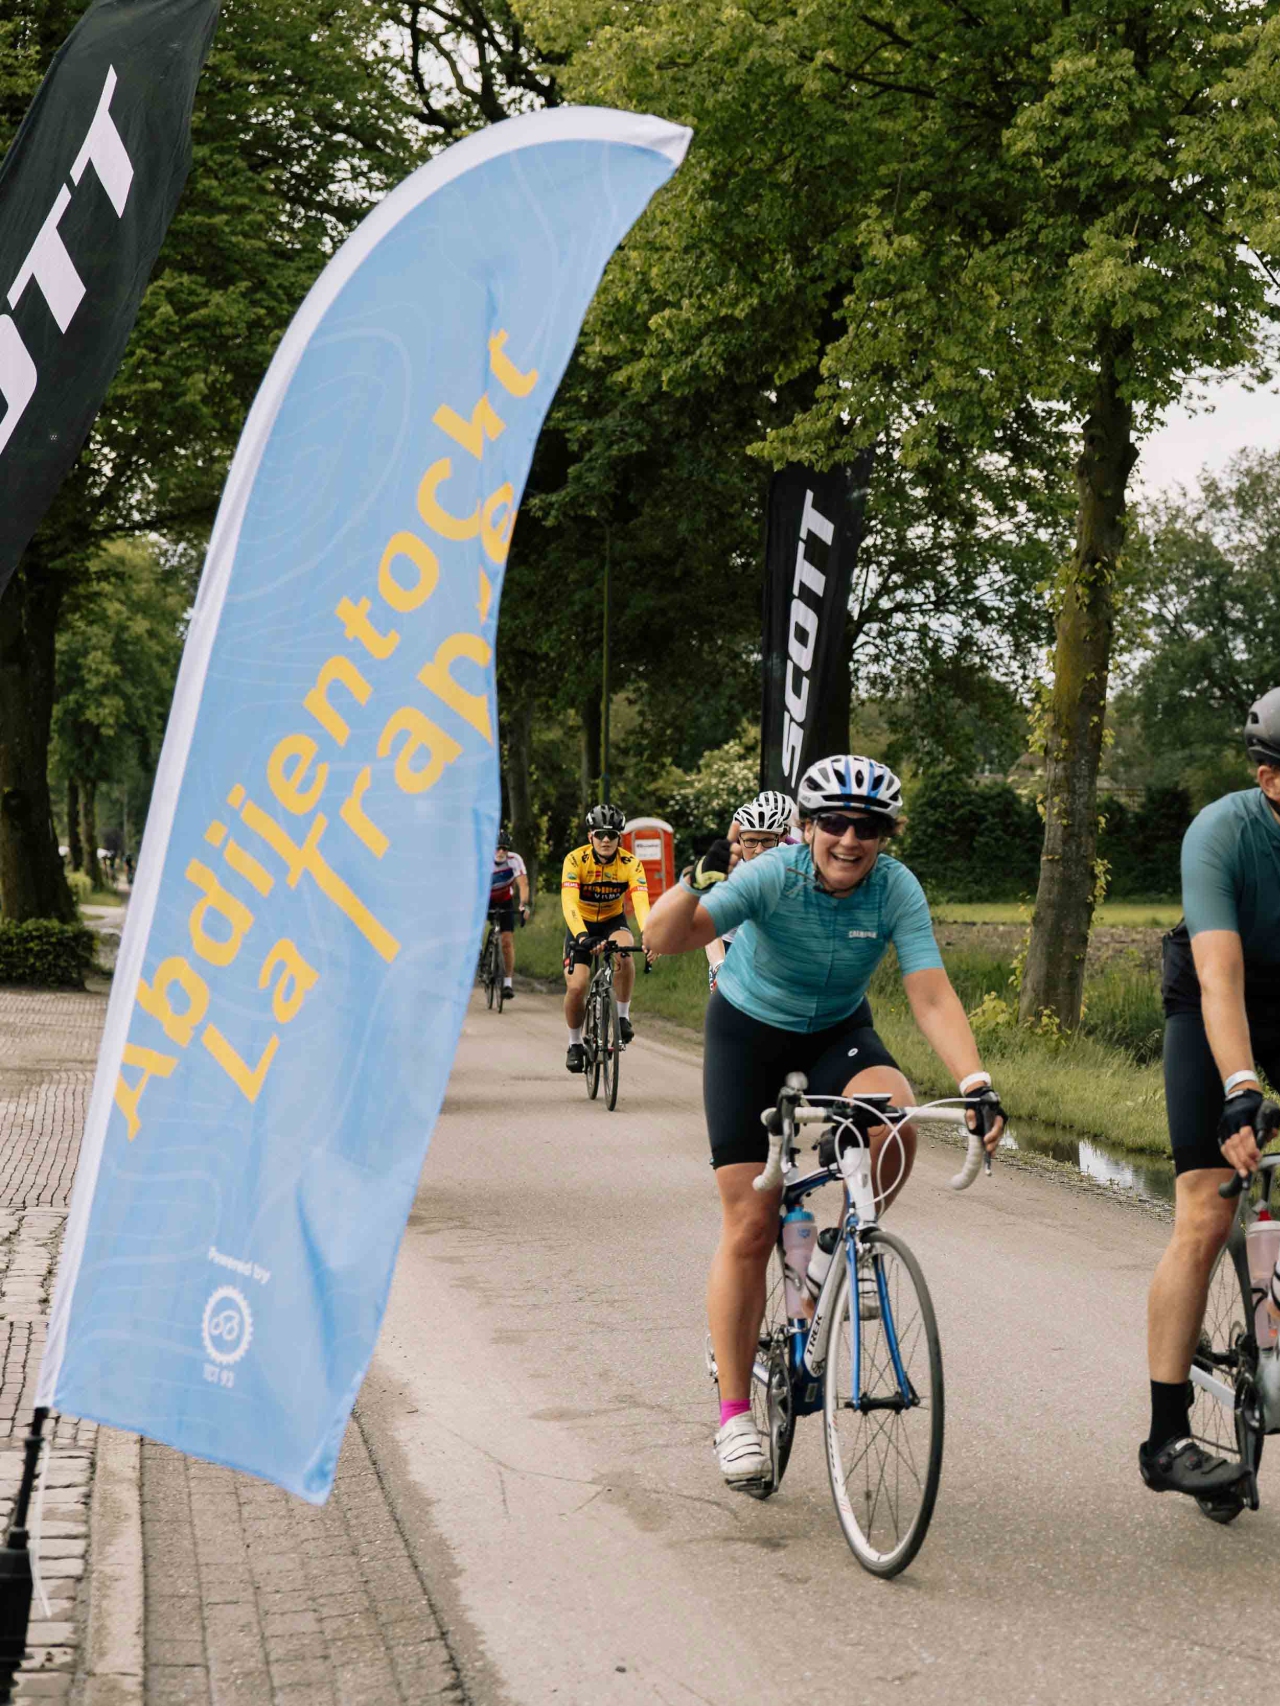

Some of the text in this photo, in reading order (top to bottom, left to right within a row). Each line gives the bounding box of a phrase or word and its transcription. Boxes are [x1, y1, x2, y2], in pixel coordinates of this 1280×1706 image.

[782, 489, 834, 788] SCOTT
[201, 938, 320, 1103] La
[806, 1314, 823, 1356] TREK
